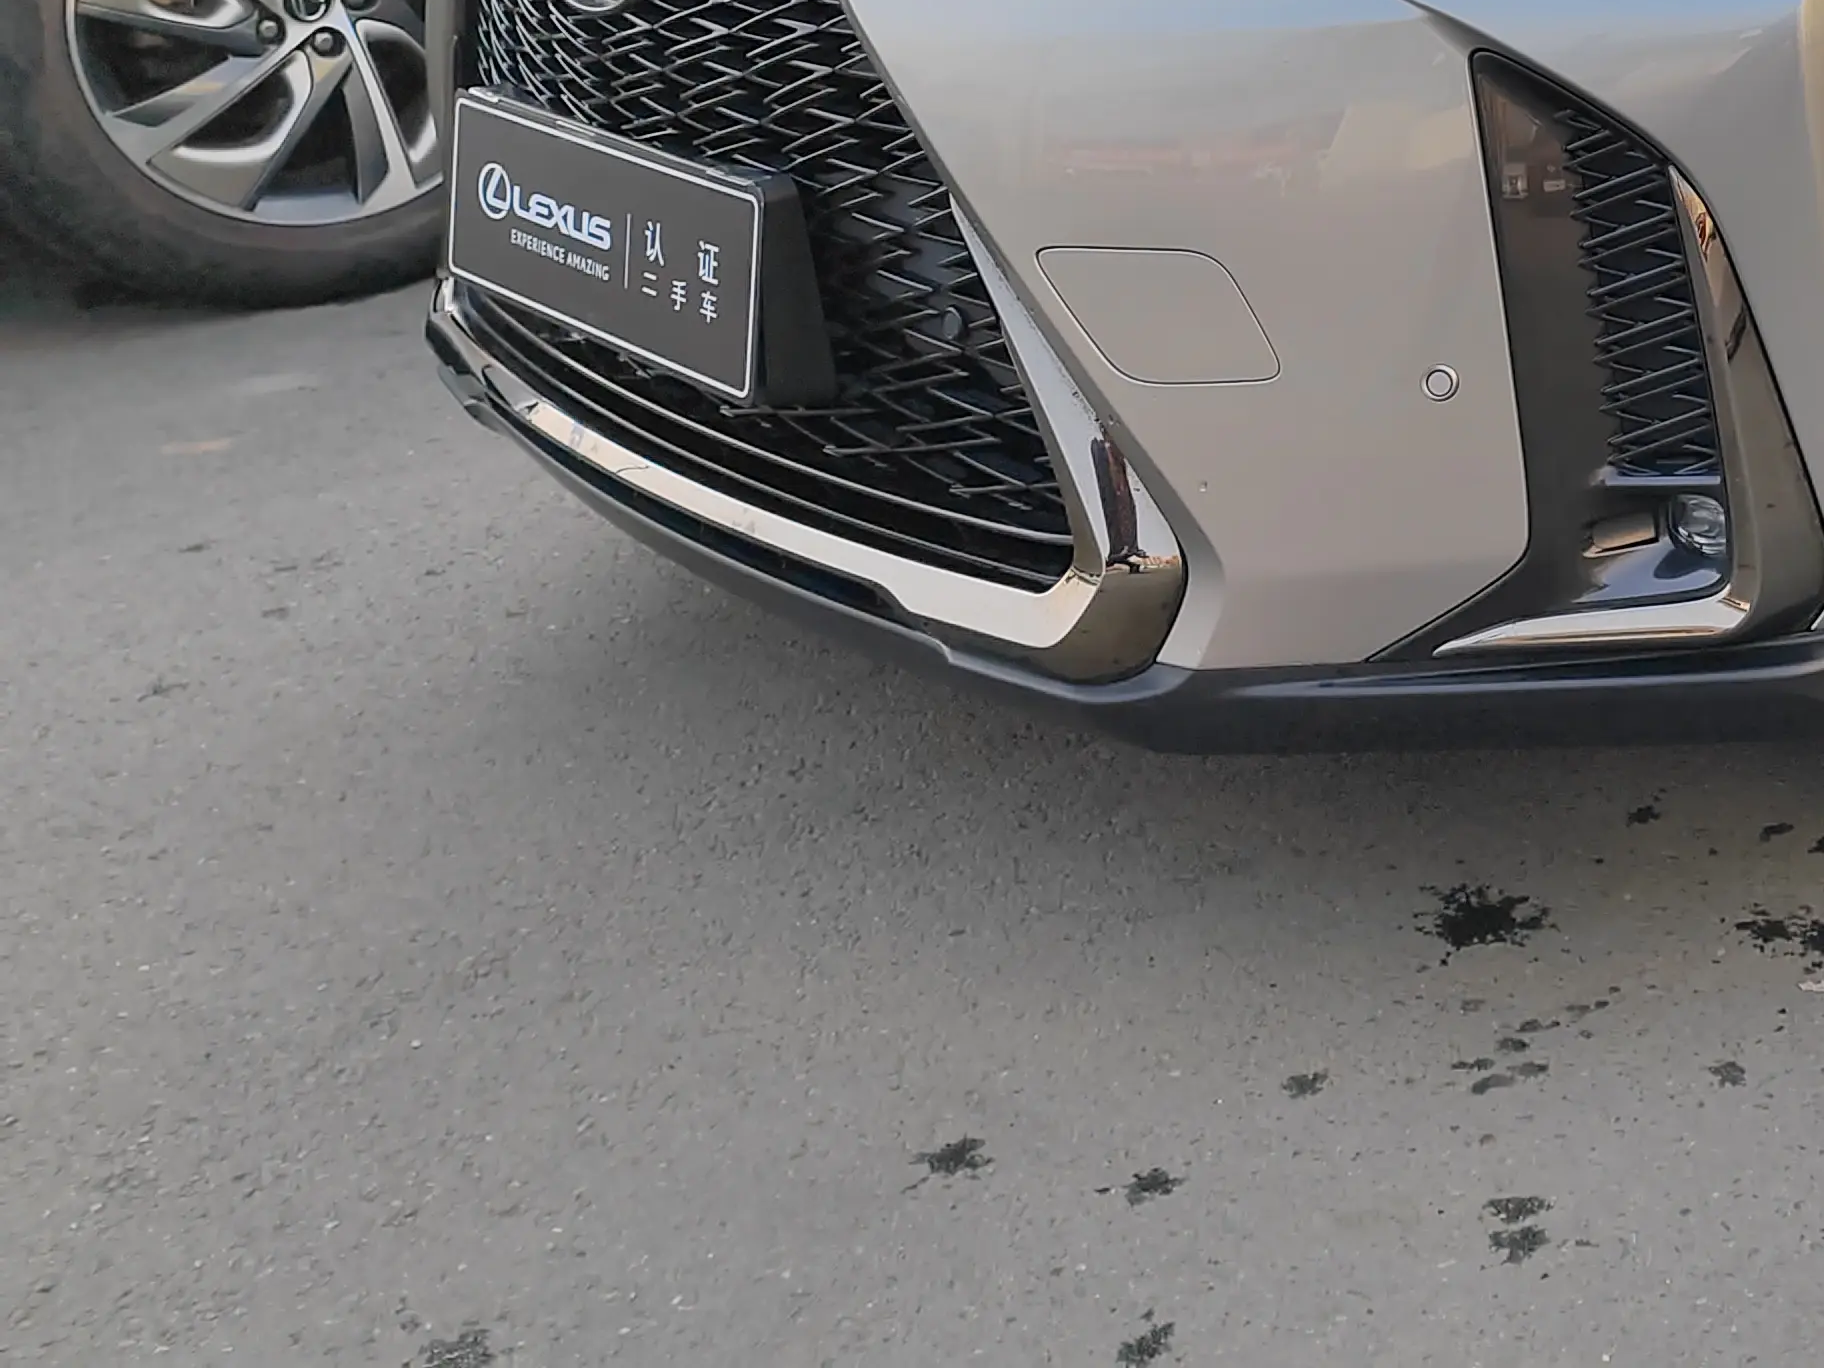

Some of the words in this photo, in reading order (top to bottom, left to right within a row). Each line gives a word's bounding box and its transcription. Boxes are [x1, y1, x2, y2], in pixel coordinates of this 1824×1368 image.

[512, 185, 612, 251] LEXUS
[510, 228, 566, 264] EXPERIENCE
[565, 250, 610, 281] AMAZING
[641, 271, 718, 324] 二手车
